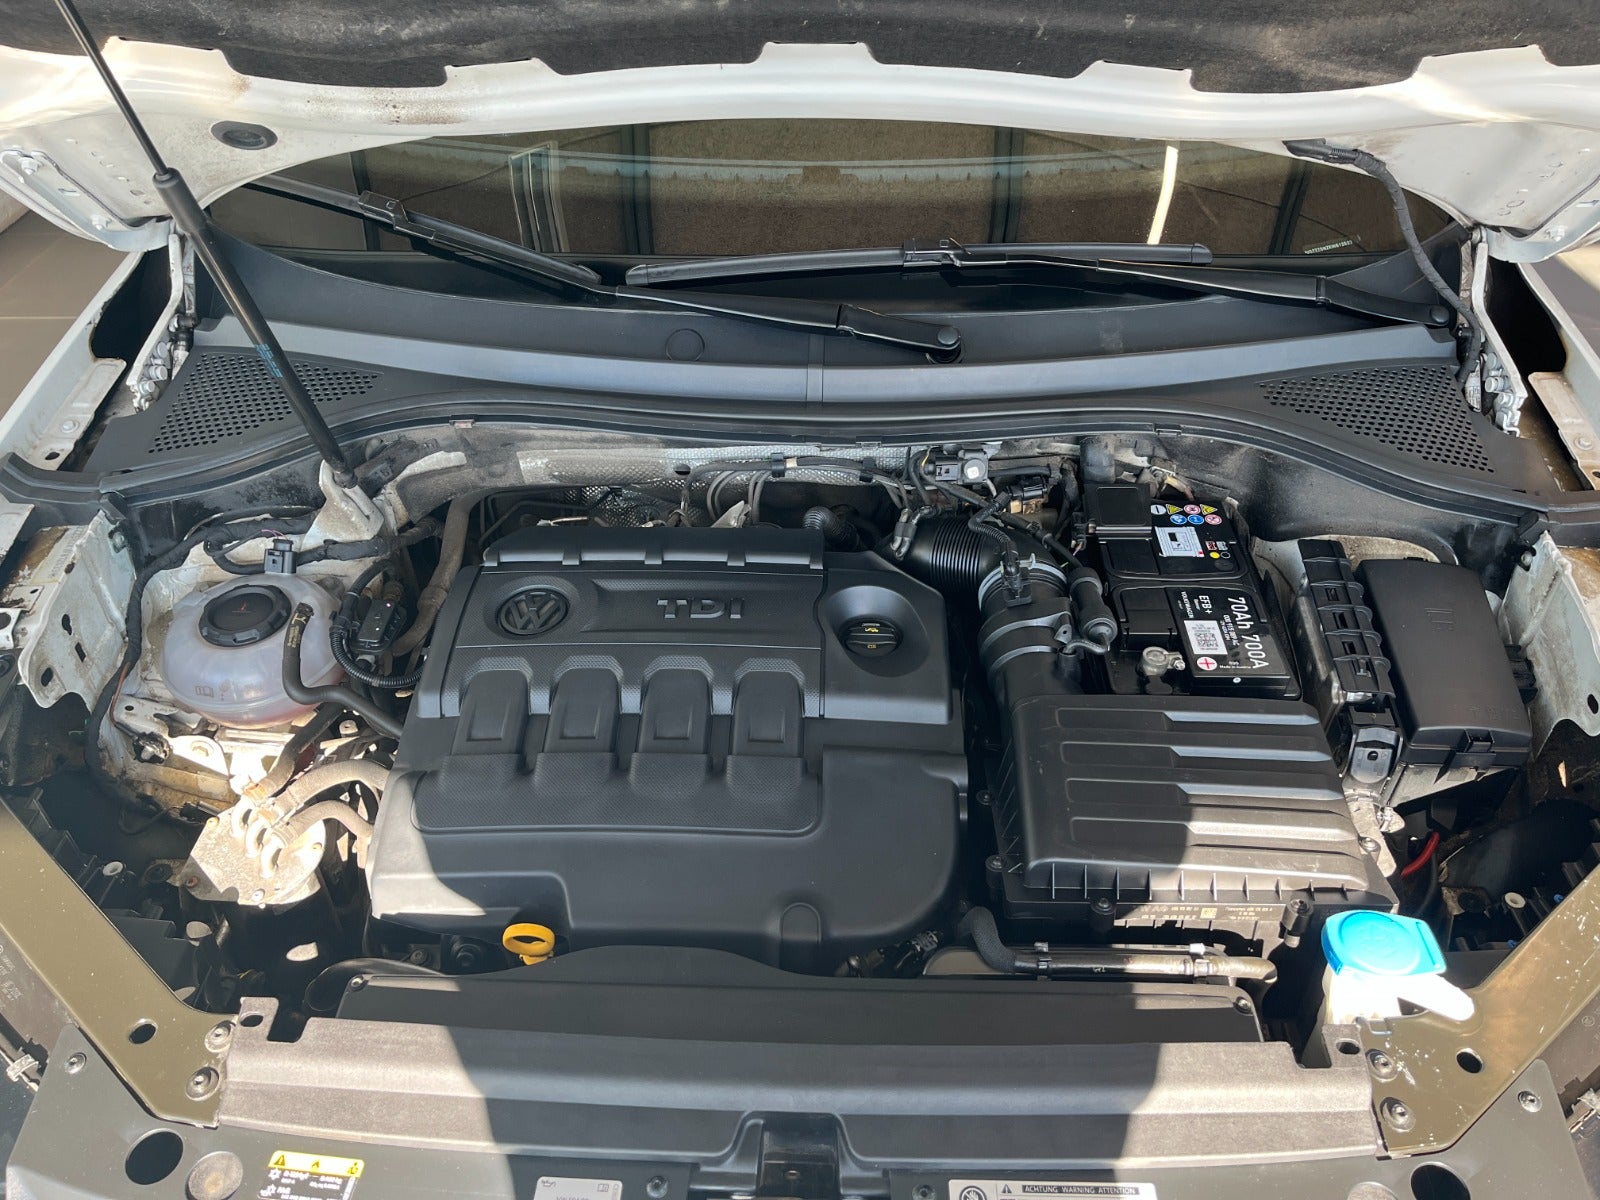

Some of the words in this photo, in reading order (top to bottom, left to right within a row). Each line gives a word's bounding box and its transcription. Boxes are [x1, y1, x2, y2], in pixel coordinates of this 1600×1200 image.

[656, 597, 746, 620] TDI
[1199, 595, 1213, 615] EFB+
[1228, 597, 1254, 629] 70Ah
[1241, 634, 1269, 669] 700A
[1024, 1185, 1059, 1194] ACHTUNG
[1062, 1186, 1095, 1194] WARNING
[1097, 1186, 1136, 1195] ATTENTION
